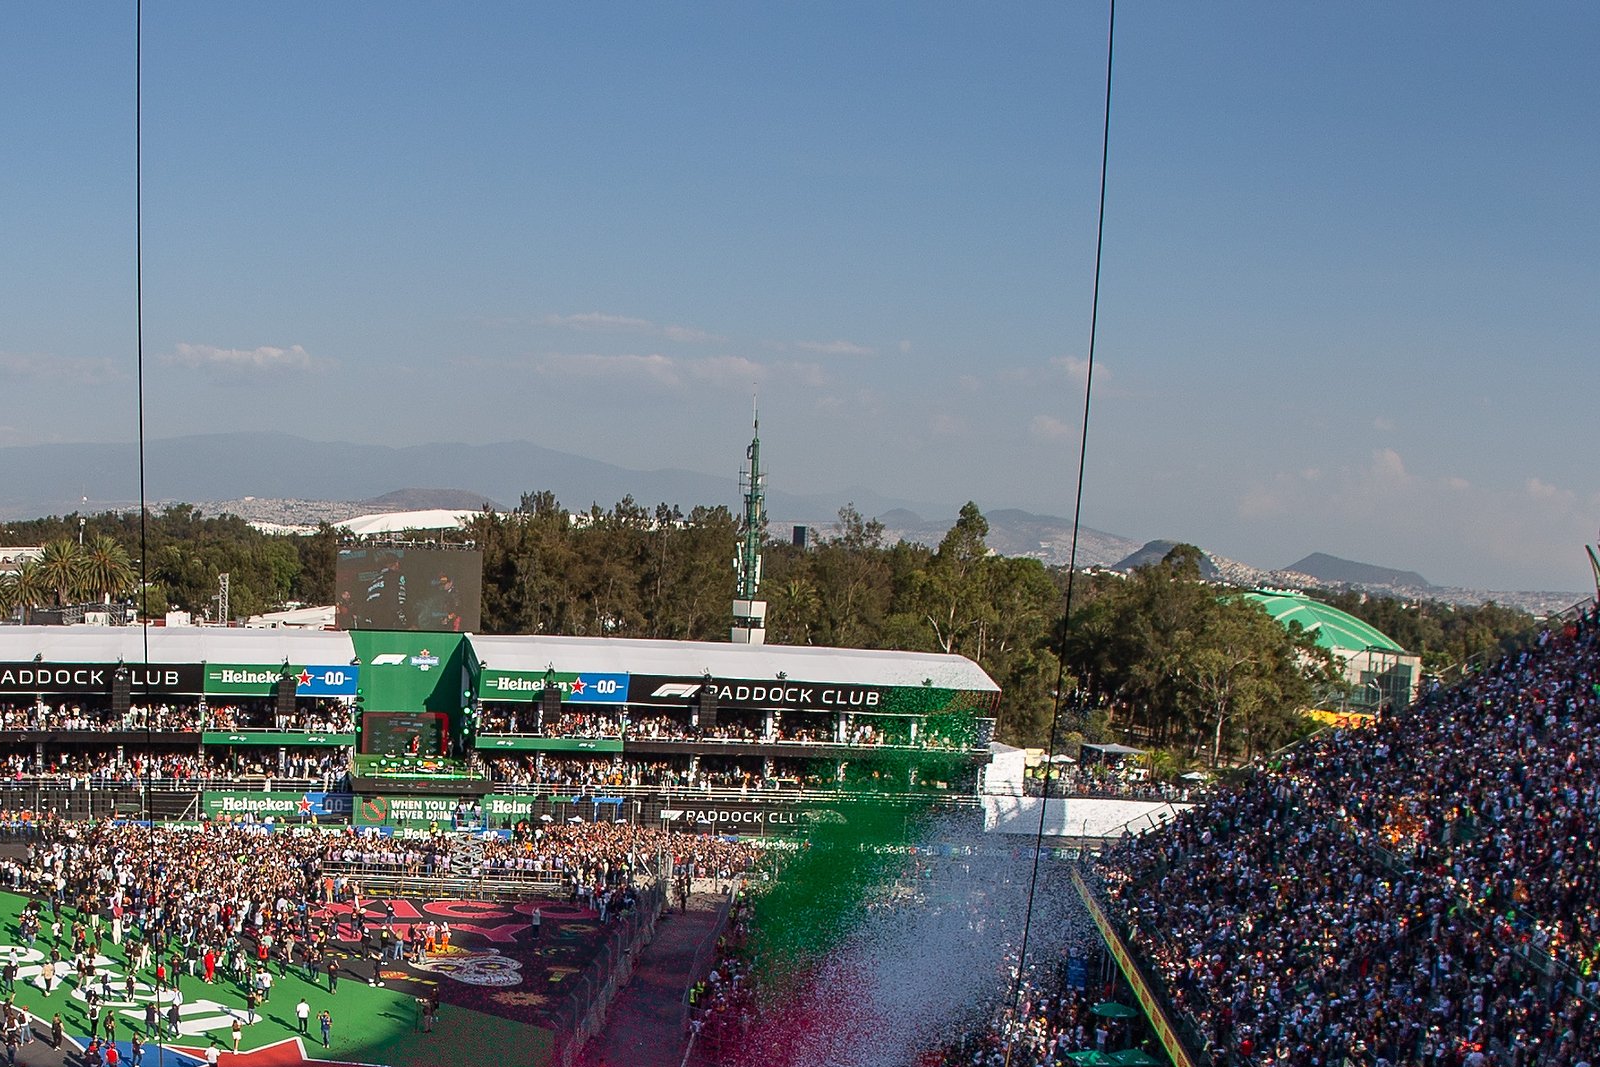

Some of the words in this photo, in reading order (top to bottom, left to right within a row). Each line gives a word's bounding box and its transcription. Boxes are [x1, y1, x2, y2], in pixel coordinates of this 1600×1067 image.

[120, 670, 179, 685] LUB
[221, 669, 289, 685] Heineke
[822, 690, 880, 706] CLUB
[222, 797, 295, 811] Heineken
[391, 800, 423, 811] WHEN
[425, 800, 447, 811] YOU
[391, 811, 424, 821] NEVER
[686, 810, 763, 823] PADDOCK
[768, 812, 800, 824] CLU
